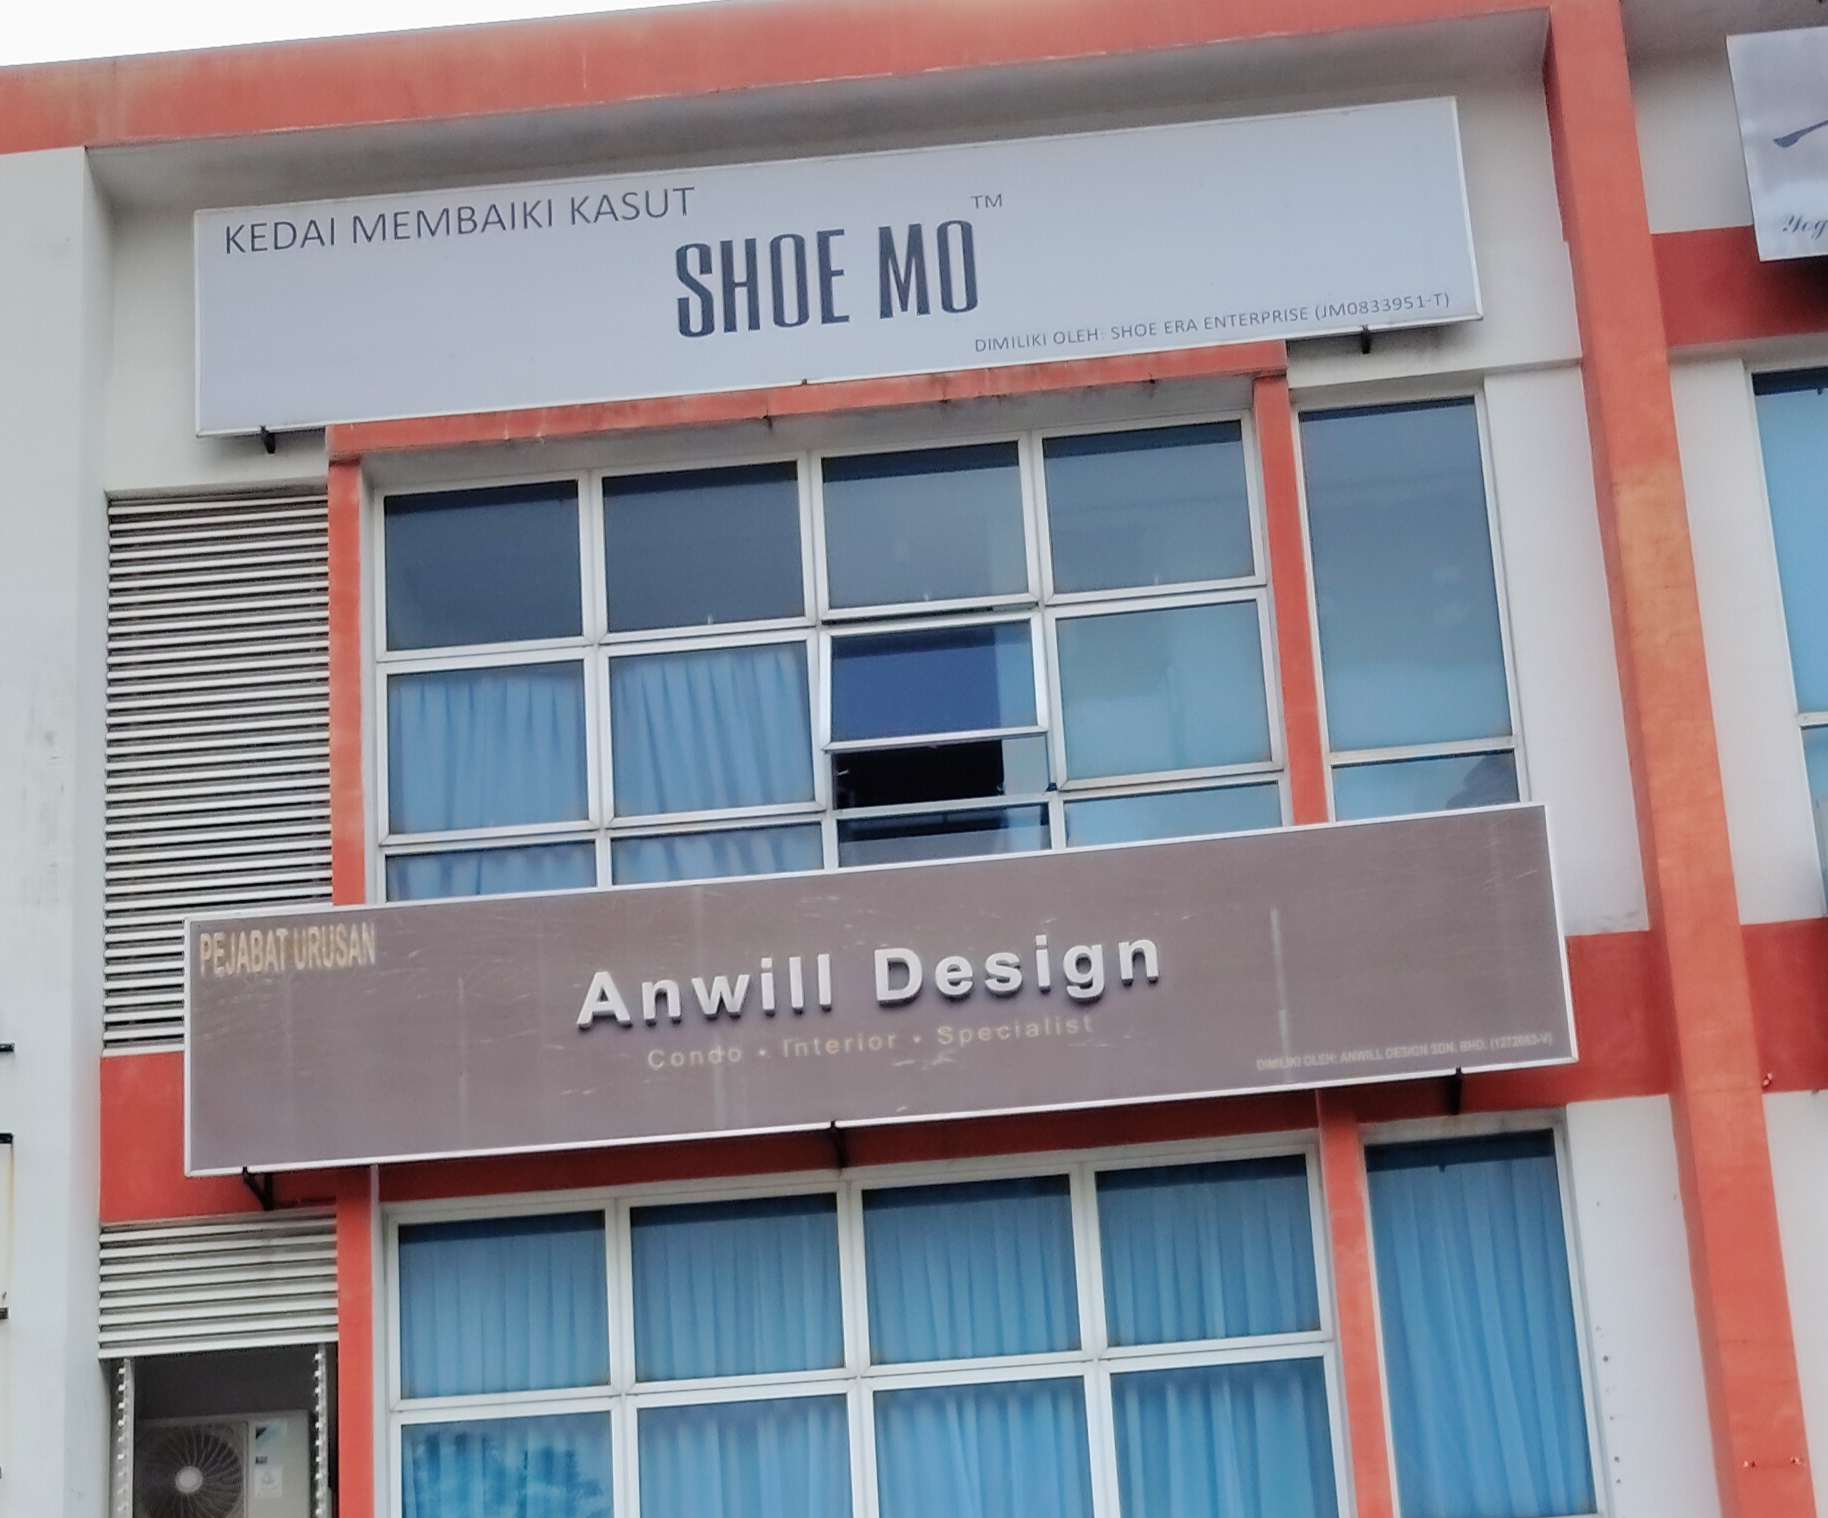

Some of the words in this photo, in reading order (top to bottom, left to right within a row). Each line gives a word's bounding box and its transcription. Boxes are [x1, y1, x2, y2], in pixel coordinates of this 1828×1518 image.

[225, 216, 337, 255] KEDAI
[353, 196, 554, 243] MEMBAIKI
[571, 186, 696, 224] KASUT
[675, 229, 850, 339] SHOE
[878, 219, 979, 319] MO
[974, 335, 1048, 353] DIMILIKI
[1053, 330, 1105, 346] OLEH:
[1110, 322, 1158, 340] SHOE
[1164, 318, 1199, 334] ERA
[1203, 306, 1310, 331] ENTERPRISE
[1314, 291, 1452, 322] (JM0833951-T)
[200, 926, 291, 978] PEJABAT
[293, 921, 377, 973] URUSAN
[576, 953, 834, 1032] Anwill
[874, 934, 1162, 1006] Design
[647, 1042, 742, 1070] Condo
[782, 1031, 898, 1059] Interior
[936, 1014, 1095, 1049] Specialist
[1339, 1048, 1384, 1065] ANWILL
[1385, 1044, 1429, 1060] DESIGN
